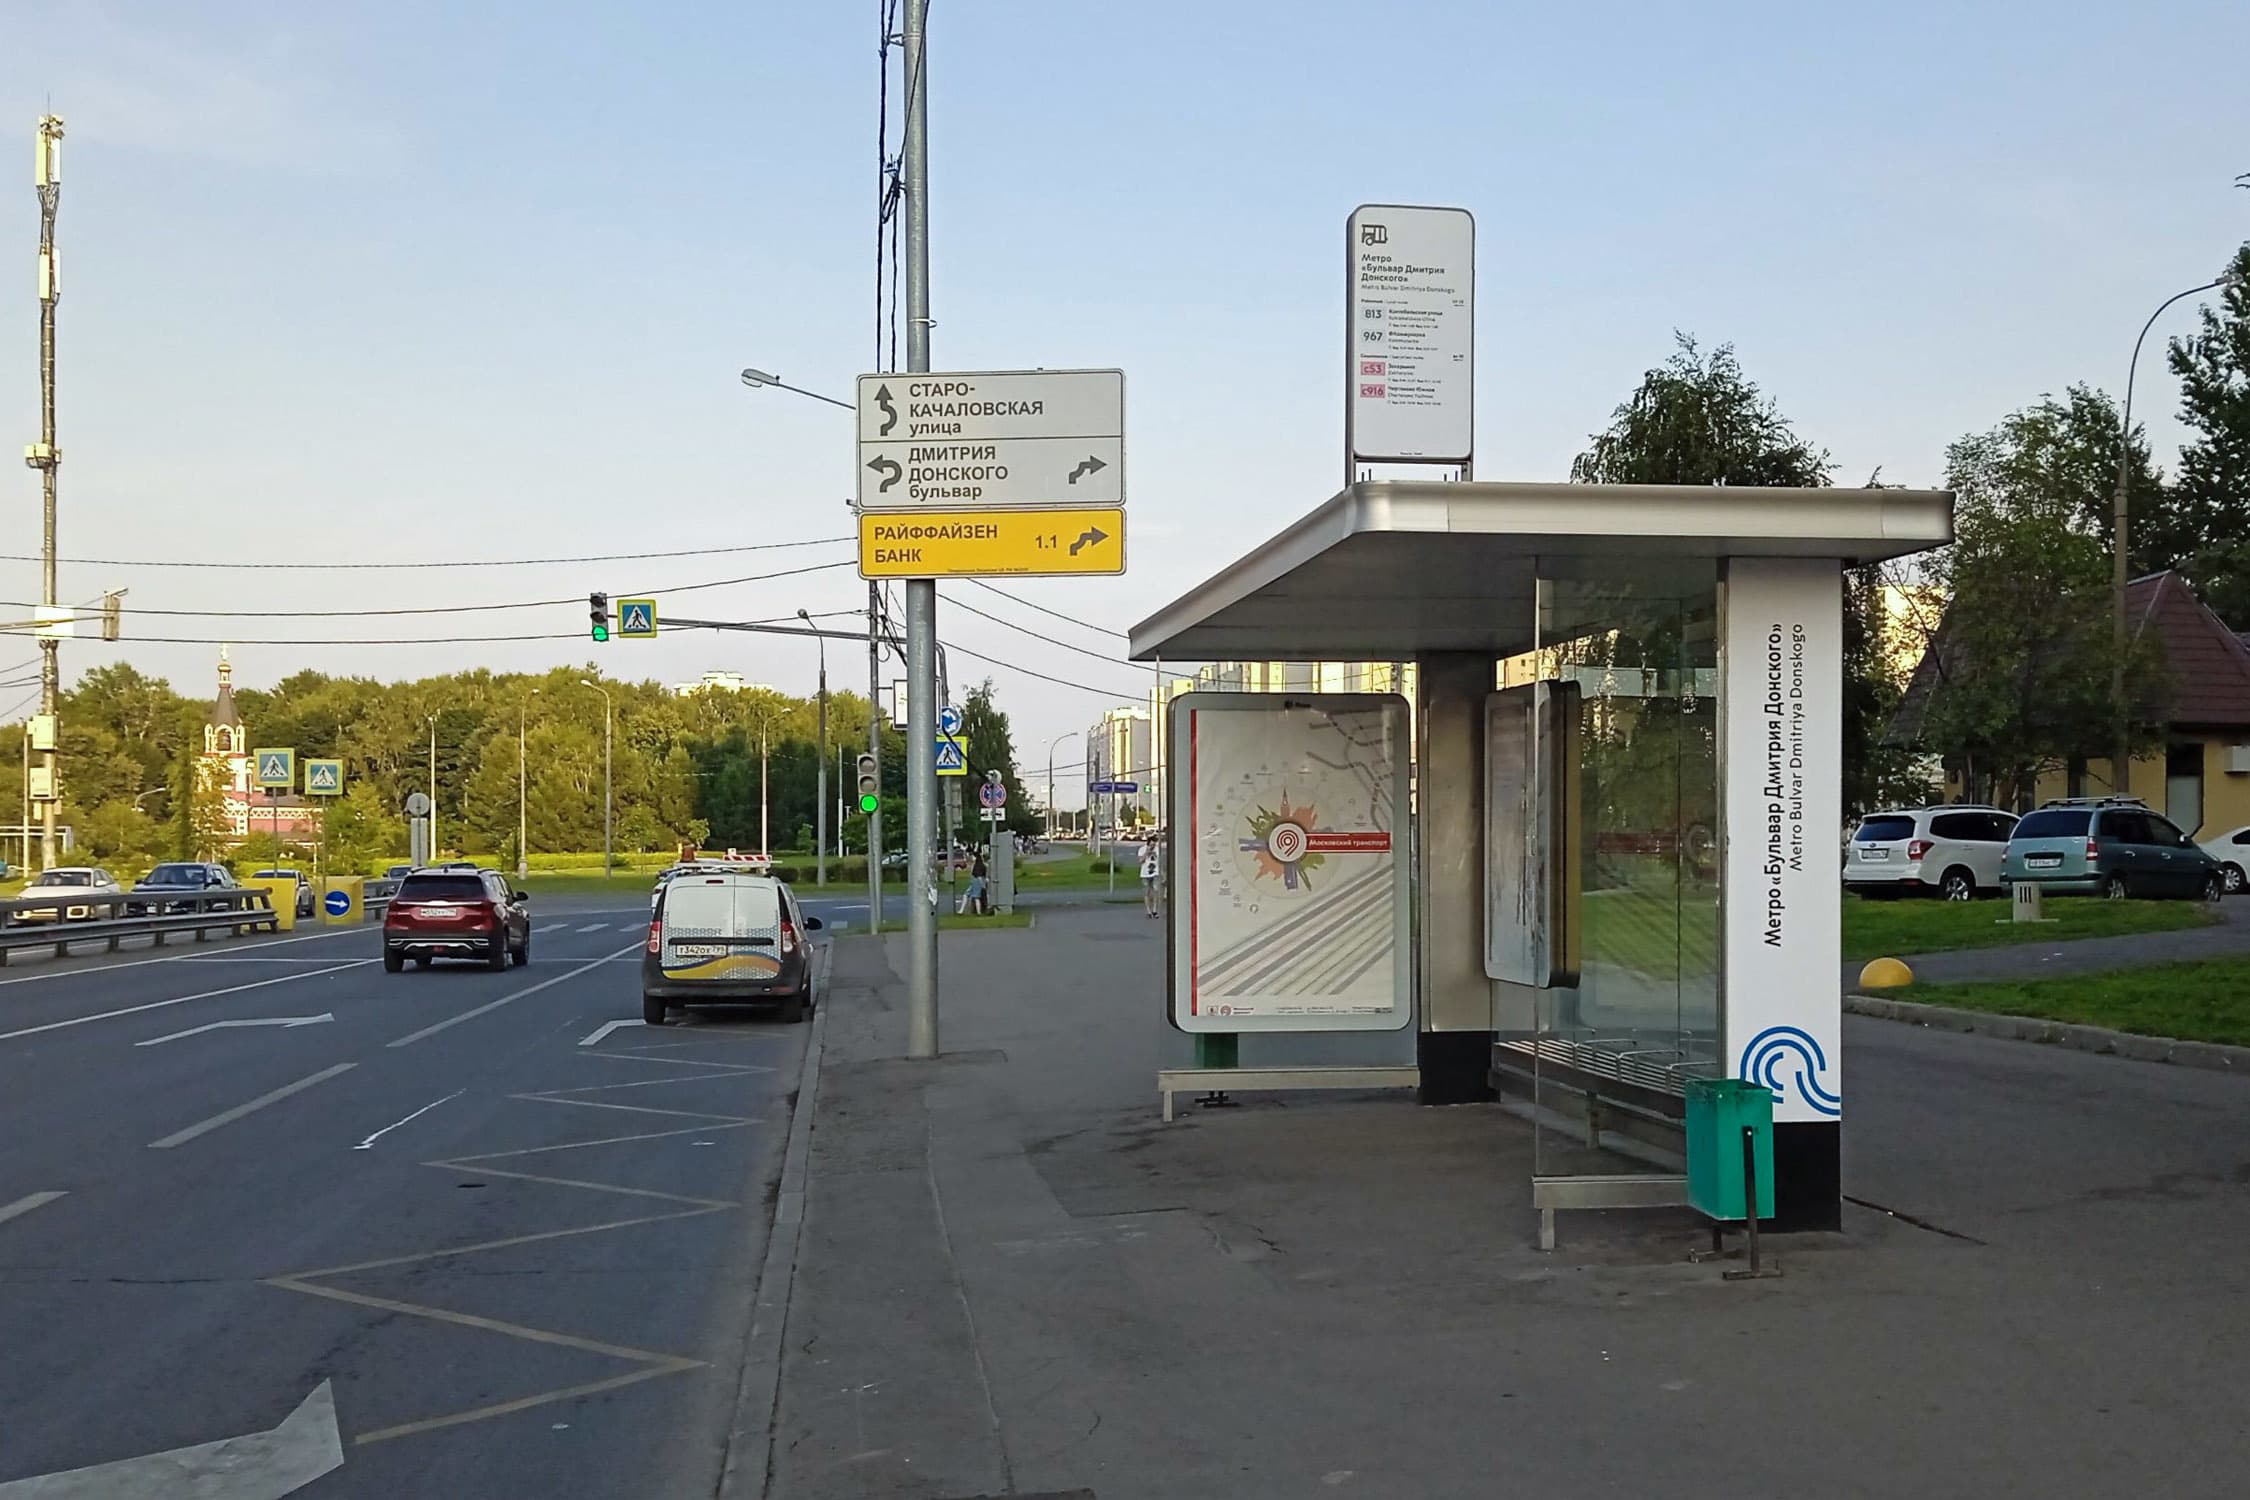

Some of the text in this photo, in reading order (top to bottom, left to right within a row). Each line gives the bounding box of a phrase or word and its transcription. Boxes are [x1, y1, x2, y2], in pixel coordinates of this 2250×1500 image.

[1361, 254, 1392, 264] Метро
[1361, 264, 1445, 275] «Бульвар Дмитрия
[1361, 273, 1409, 282] Донского»
[1365, 309, 1382, 319] 813
[1363, 331, 1383, 341] 967
[909, 383, 976, 398] СТАРО-
[909, 401, 1044, 418] КАЧАЛОВСКАЯ
[909, 422, 962, 438] улица
[908, 446, 996, 464] ДМИТРИЯ
[908, 466, 1009, 484] ДОНСКОГО
[909, 484, 982, 501] бульвар
[874, 522, 1058, 549] РАЙФФАЙЗЕН 1.1
[874, 548, 922, 563] БАНК
[1789, 624, 1806, 871] Metro Bulvar Dmitriya Donskogo
[1764, 623, 1786, 947] Метро «Бульвар Дмитрия Донского»
[1308, 838, 1388, 848] Московский транспорт
